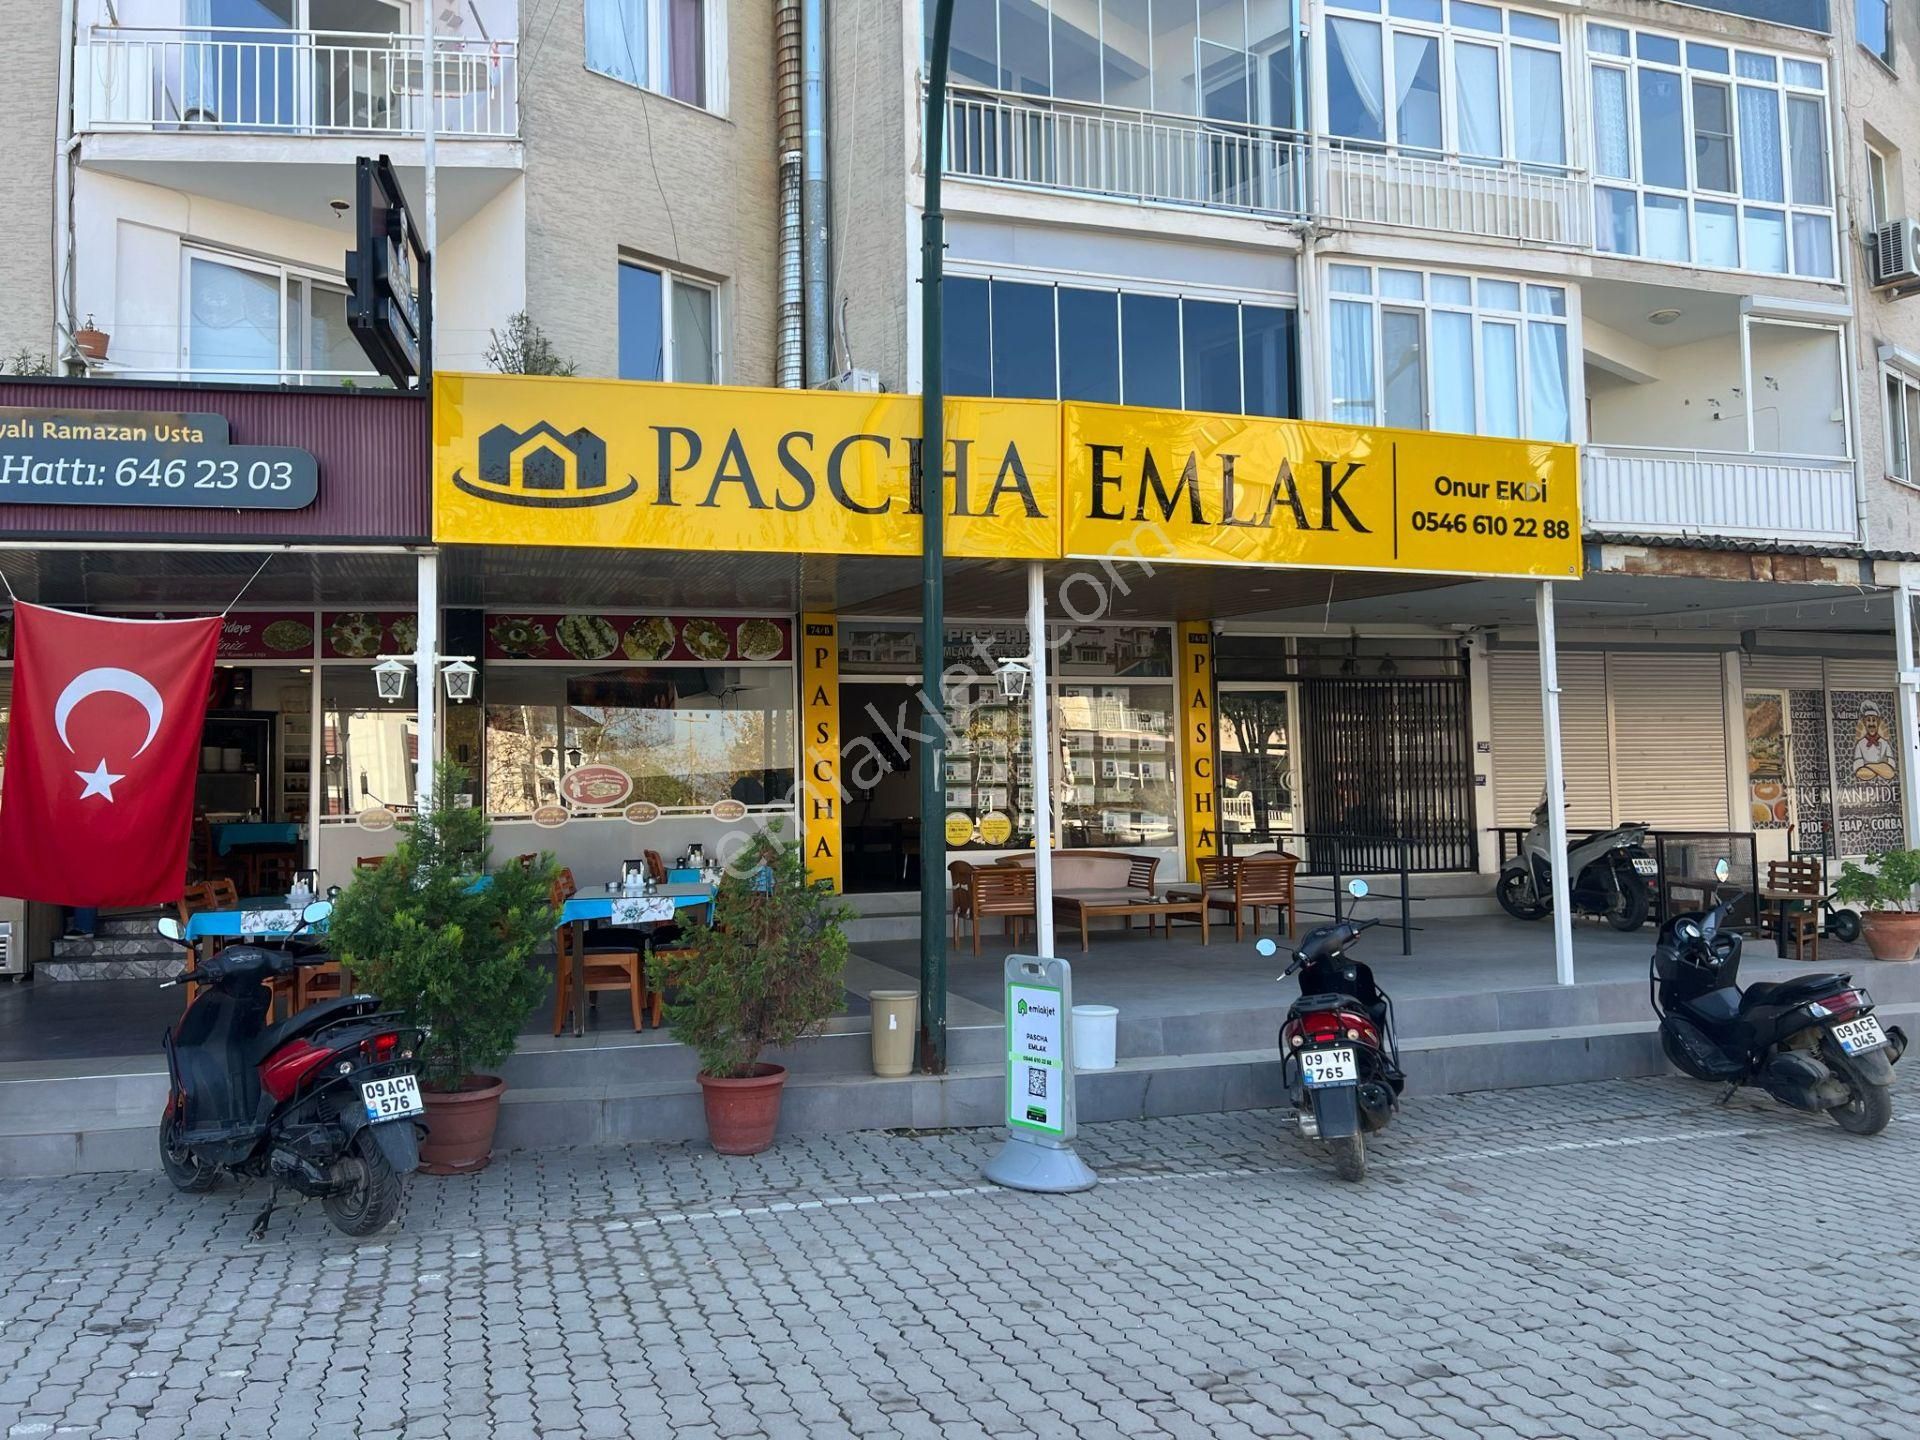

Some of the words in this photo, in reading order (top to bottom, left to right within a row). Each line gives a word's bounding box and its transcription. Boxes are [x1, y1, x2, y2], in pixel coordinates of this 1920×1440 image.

[42, 422, 147, 442] Ramazan
[154, 424, 204, 443] Usta
[0, 454, 105, 487] Hattı:
[115, 457, 187, 488] 646
[193, 459, 239, 490] 23
[248, 461, 294, 491] 03
[649, 425, 1048, 519] PASCHA
[1085, 442, 1373, 534] EMLAK
[1434, 476, 1490, 499] Onur
[1496, 478, 1547, 503] EKDİ
[1412, 511, 1467, 533] 0546
[1473, 514, 1508, 536] 610
[1513, 517, 1538, 538] 22
[1543, 519, 1570, 540] 88
[943, 646, 973, 657] MLAK
[812, 647, 834, 858] PASCHA
[1191, 653, 1213, 848] PASCHA
[1801, 819, 1824, 834] PİDE
[1839, 819, 1863, 833] EBAP
[1029, 1002, 1056, 1018] emlakjet
[1026, 1032, 1048, 1043] PASCHA
[1836, 1025, 1854, 1039] 09
[1853, 1018, 1877, 1035] ACE
[1028, 1043, 1047, 1053] EMLAK
[1852, 1032, 1877, 1048] 045
[1305, 1054, 1323, 1066] 09
[1333, 1051, 1352, 1064] YR
[1316, 1067, 1344, 1081] 765
[365, 1083, 385, 1099] 09
[388, 1077, 415, 1096] ACH
[381, 1095, 410, 1113] 576
